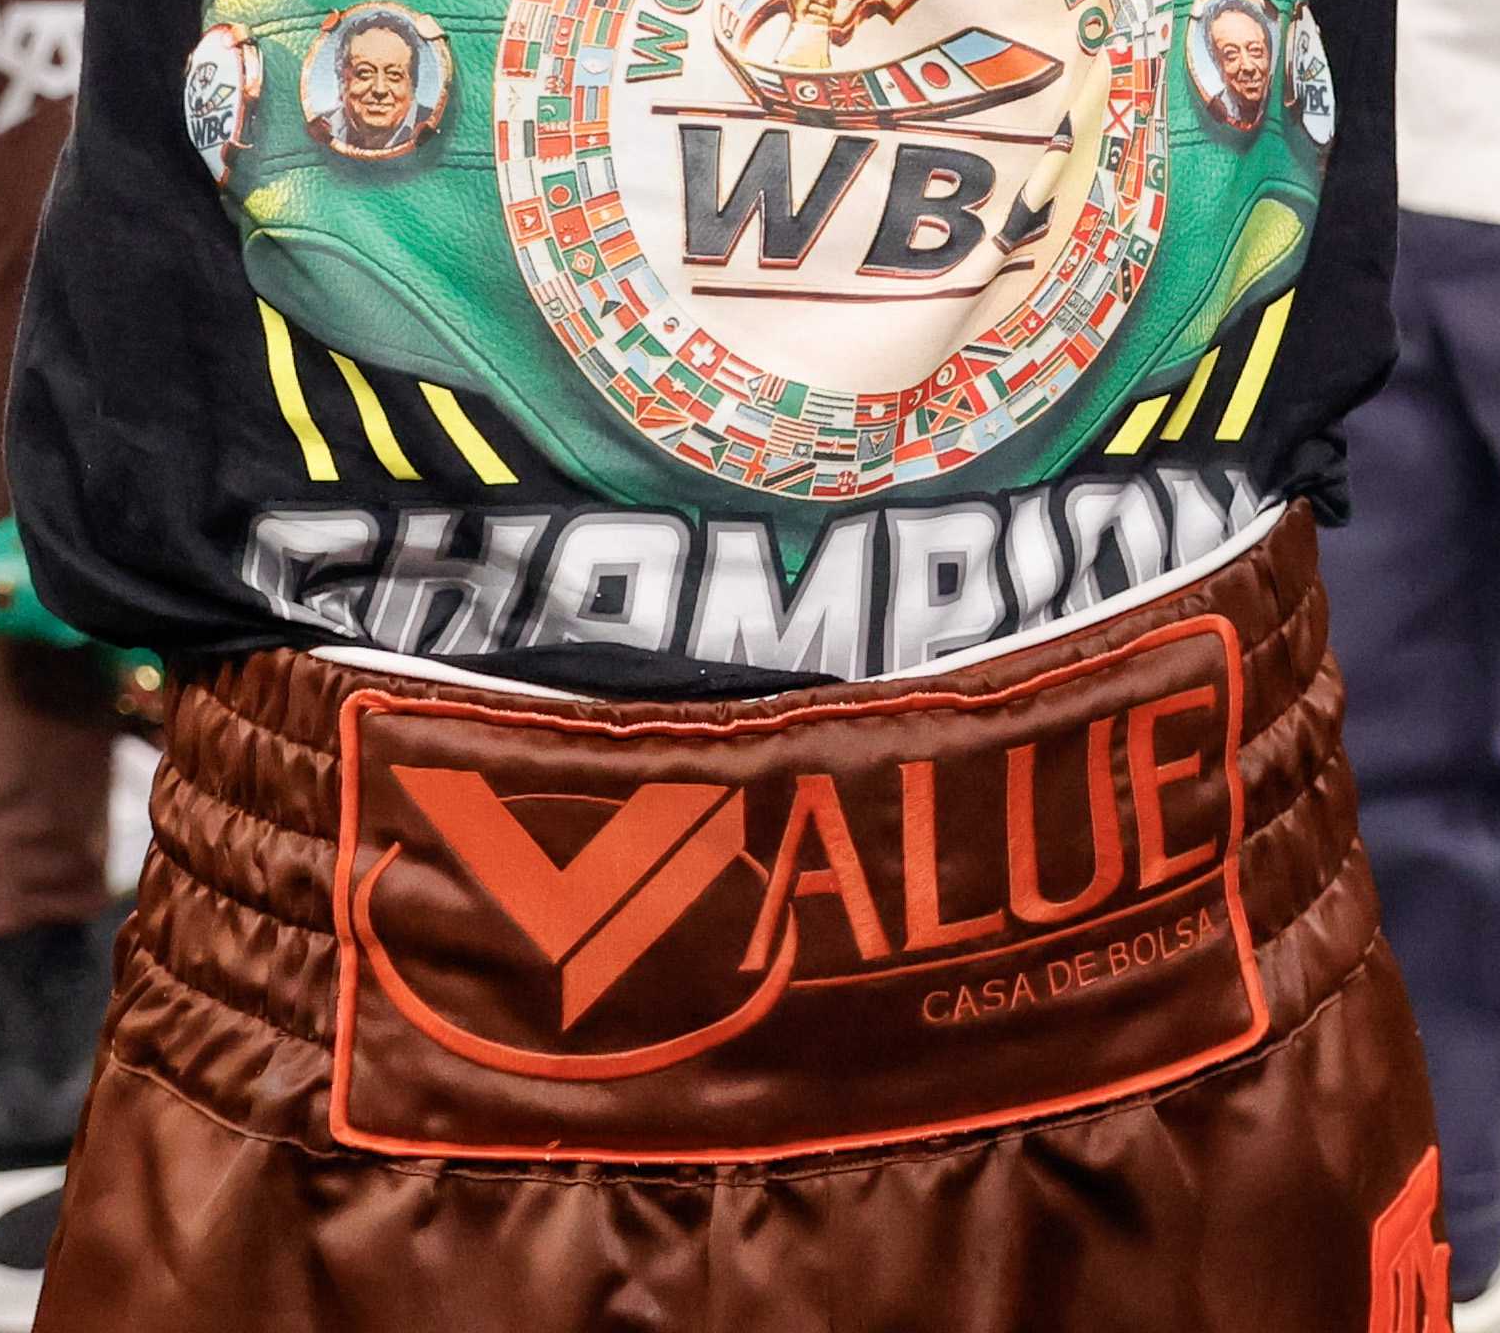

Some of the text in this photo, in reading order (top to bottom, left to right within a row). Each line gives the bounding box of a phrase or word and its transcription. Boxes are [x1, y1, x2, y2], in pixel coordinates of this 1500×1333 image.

[191, 110, 234, 150] WBC
[242, 466, 1278, 674] CHAMPION
[922, 907, 1218, 1024] CASA DE BOLSA
